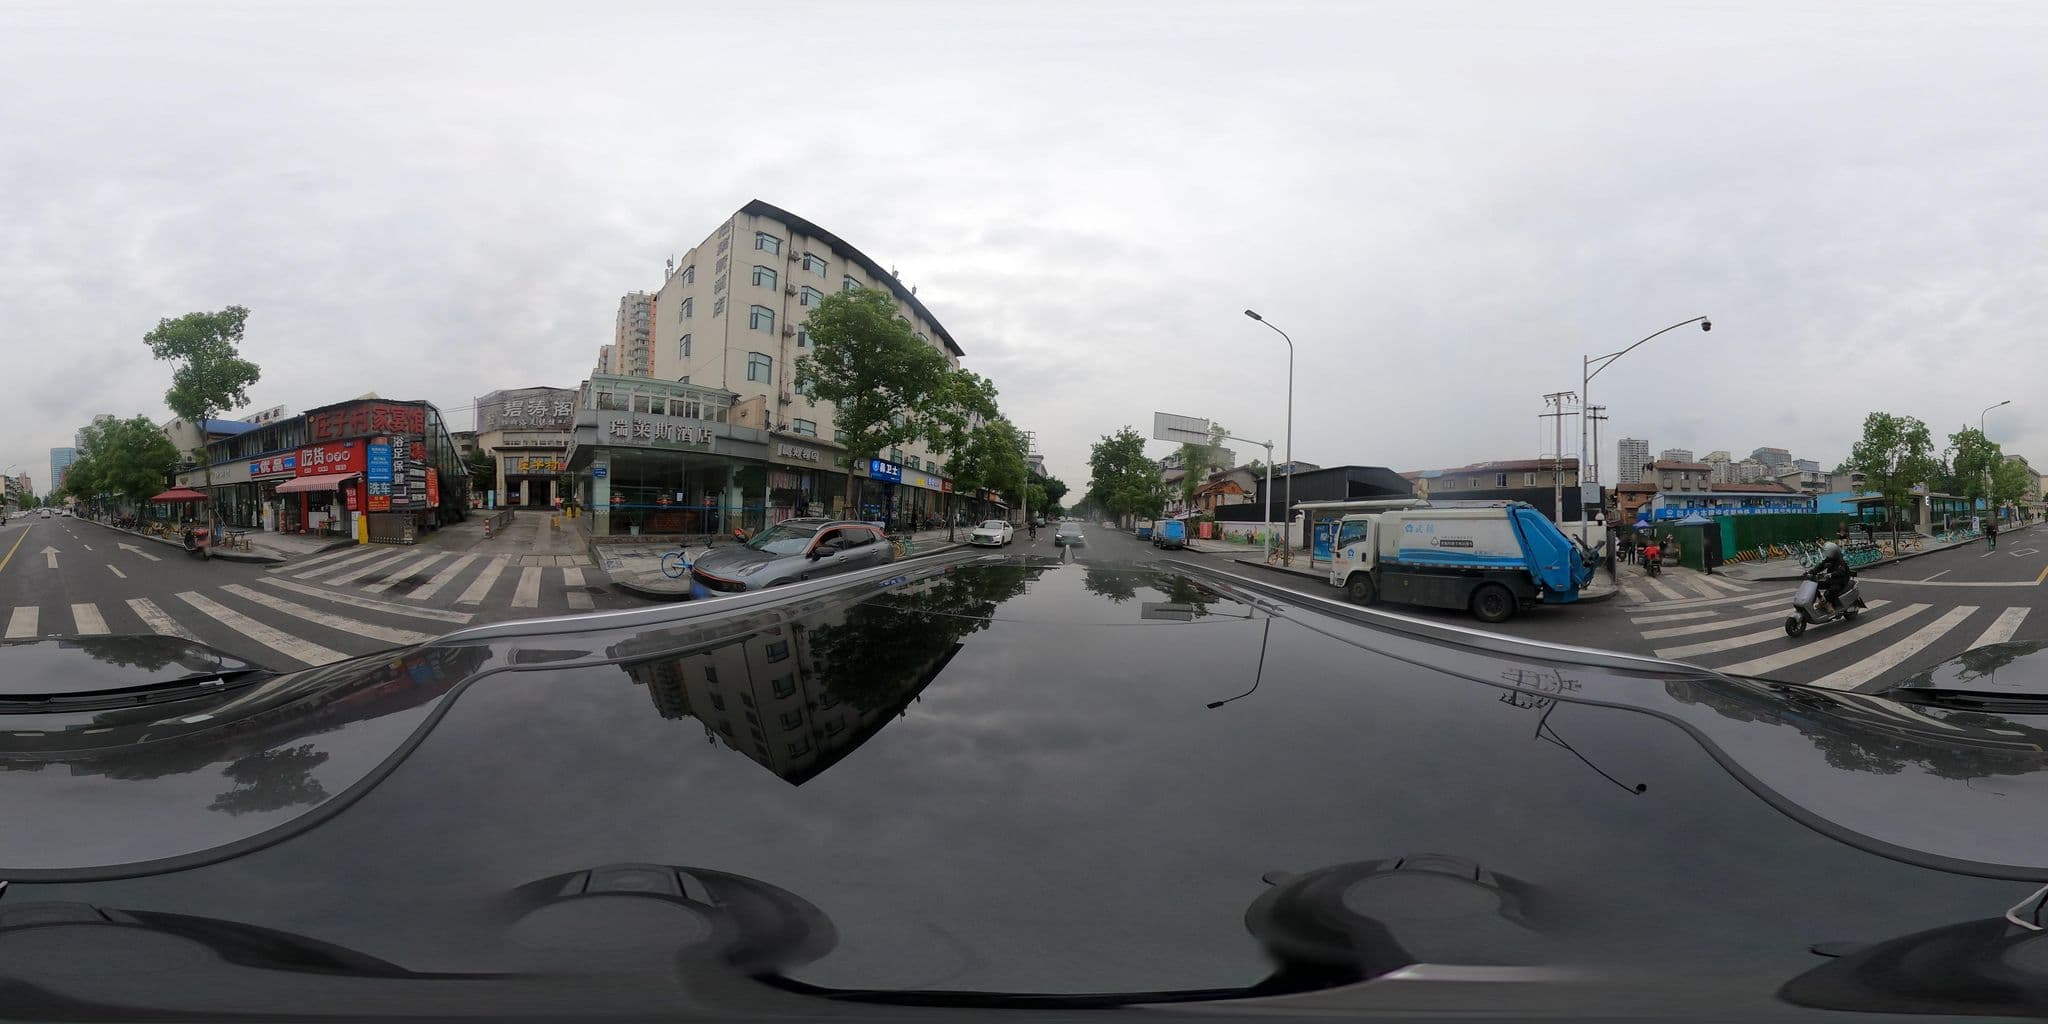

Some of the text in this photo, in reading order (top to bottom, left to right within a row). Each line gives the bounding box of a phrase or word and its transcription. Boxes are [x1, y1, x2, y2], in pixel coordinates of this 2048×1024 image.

[608, 419, 713, 444] 瑞莱斯酒店
[369, 482, 391, 495] 洗车
